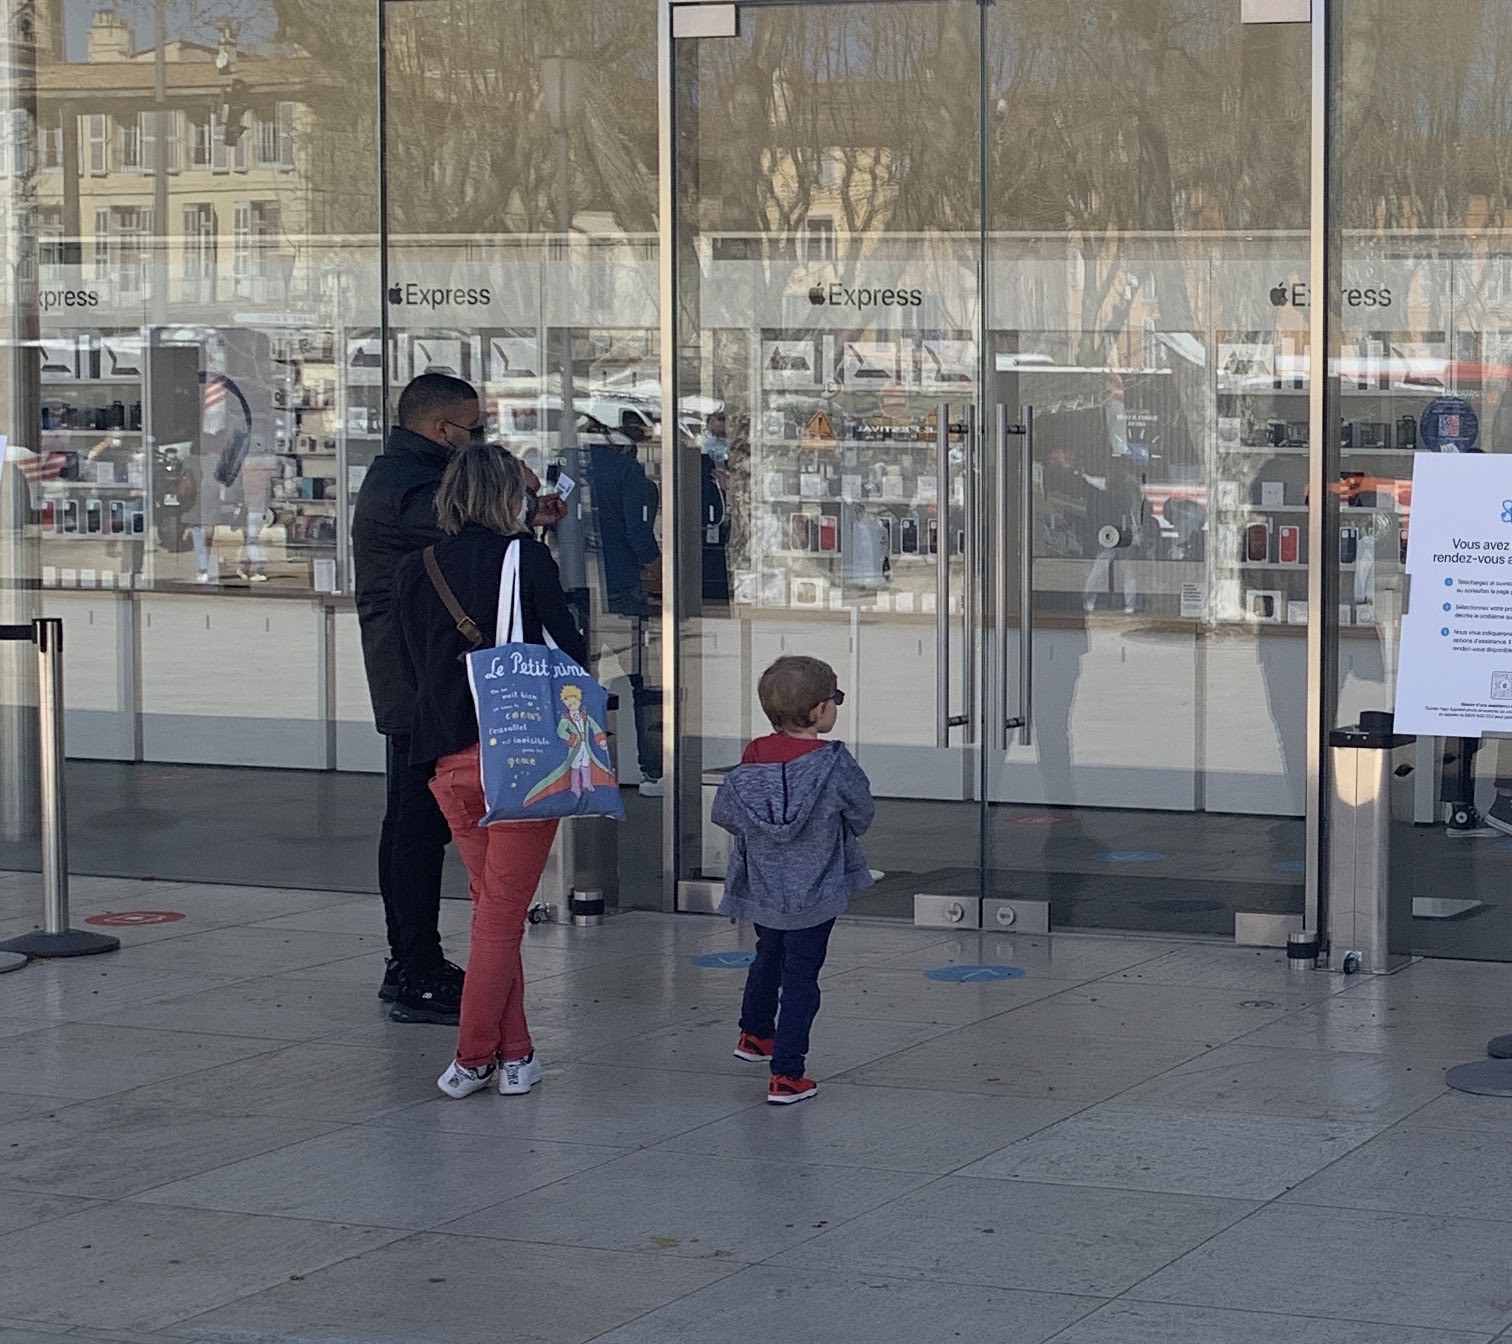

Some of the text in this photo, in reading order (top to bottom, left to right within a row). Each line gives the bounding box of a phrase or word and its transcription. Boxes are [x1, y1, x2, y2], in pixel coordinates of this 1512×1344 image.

[40, 290, 98, 311] press
[406, 283, 490, 310] Express
[829, 283, 922, 311] Express
[1292, 283, 1391, 307] Eress
[1452, 538, 1480, 550] Vous
[1483, 540, 1510, 551] avez
[1433, 553, 1505, 564] rendez-vous
[485, 656, 505, 679] Le
[510, 652, 550, 676] Petit
